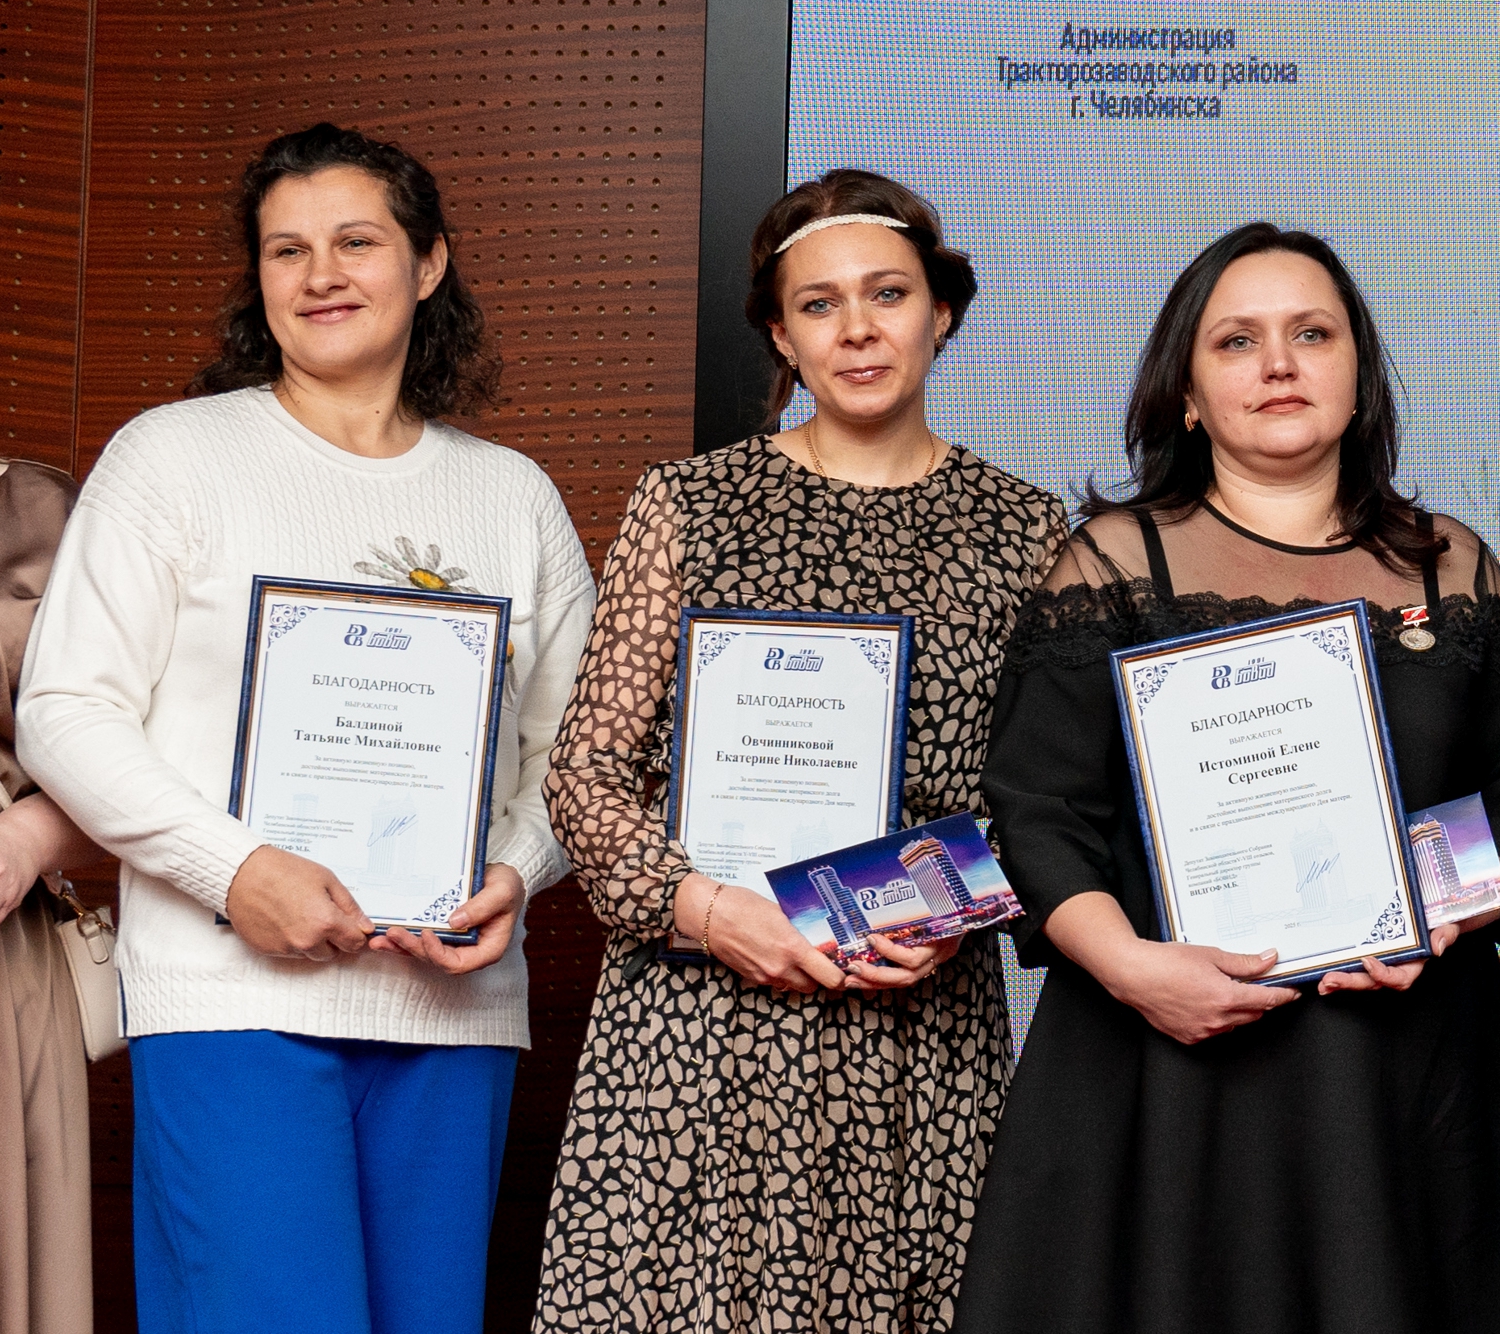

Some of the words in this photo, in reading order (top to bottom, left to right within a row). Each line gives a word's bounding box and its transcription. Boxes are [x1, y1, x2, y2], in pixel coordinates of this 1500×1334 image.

[1060, 22, 1236, 58] Администрация
[997, 55, 1217, 90] Тракторозаводского
[1222, 56, 1299, 90] района
[1070, 95, 1085, 119] г.
[1090, 89, 1222, 119] Челябинска
[312, 673, 436, 696] БЛАГОДАРНОСТЬ
[736, 693, 846, 711] БЛАГОДАРНОСТЬ
[335, 716, 403, 733] Балдиной
[1190, 697, 1313, 733] БЛАГОДАРНОСТЬ
[294, 729, 351, 745] Татьяне
[354, 734, 442, 753] Михайловне
[741, 735, 834, 751] Овчинниковой
[716, 750, 781, 767] Екатерине
[783, 754, 858, 770] Николаевне
[1198, 747, 1276, 774] Истоминой
[1279, 740, 1320, 756] Елене
[1227, 763, 1298, 785] Сергеевне
